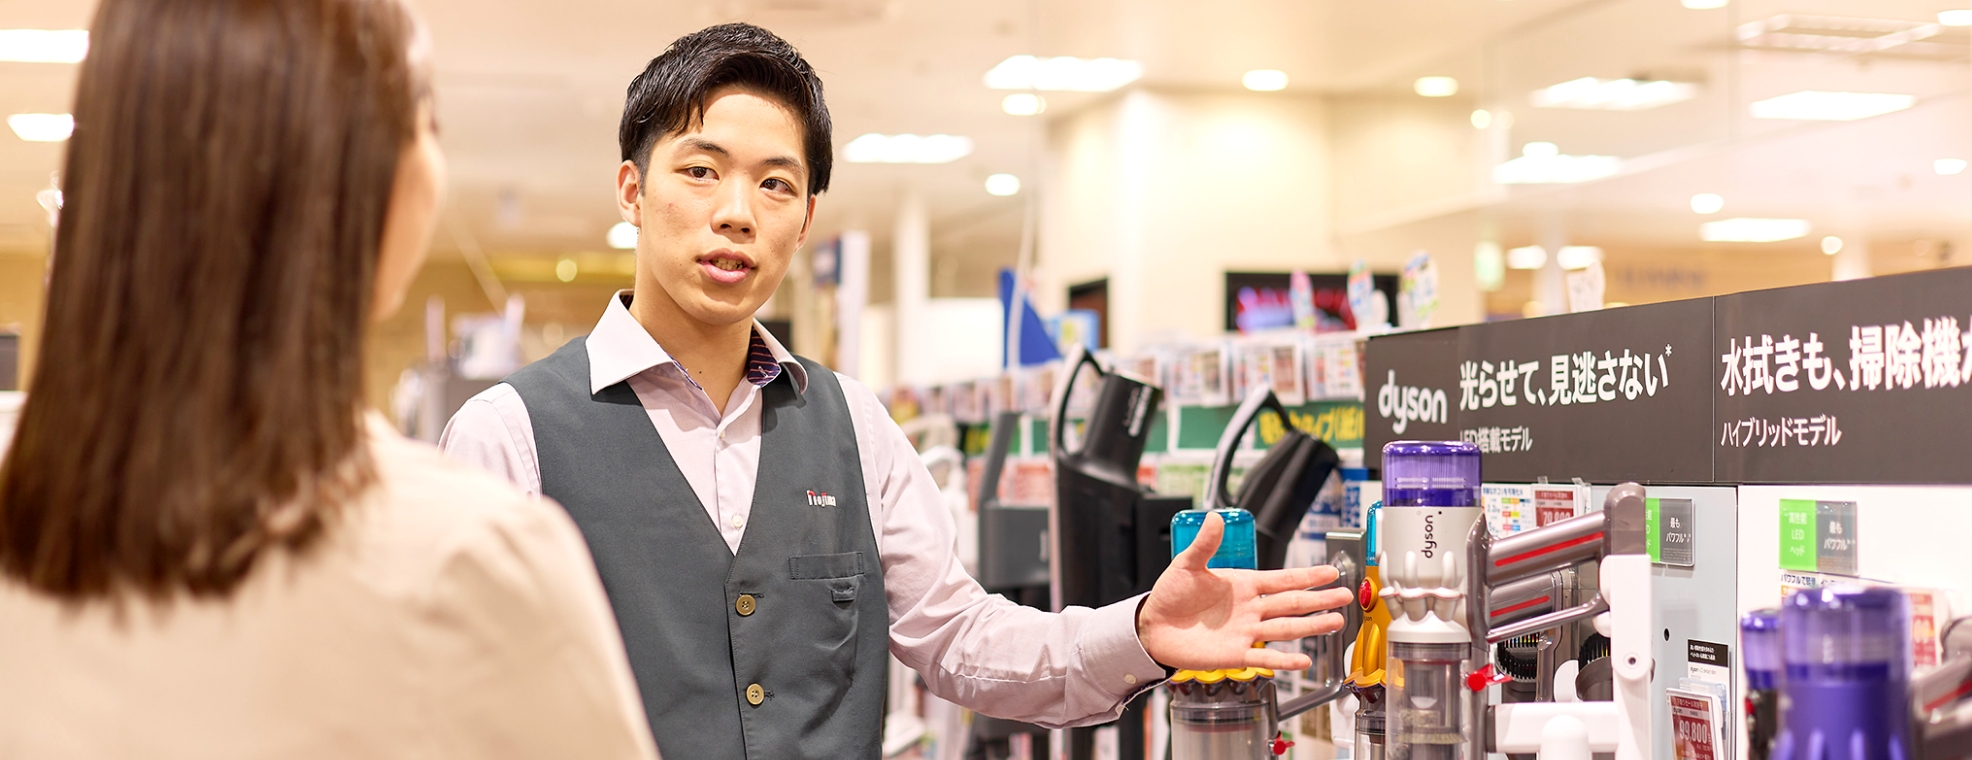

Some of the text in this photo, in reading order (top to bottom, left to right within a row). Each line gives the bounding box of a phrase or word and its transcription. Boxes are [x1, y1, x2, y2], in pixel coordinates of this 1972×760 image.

[1378, 369, 1448, 435] dyson
[1720, 413, 1843, 448] ハイブリッドモデル
[1421, 515, 1437, 559] dyson
[1790, 529, 1805, 541] LED
[1679, 719, 1707, 744] 99,800
